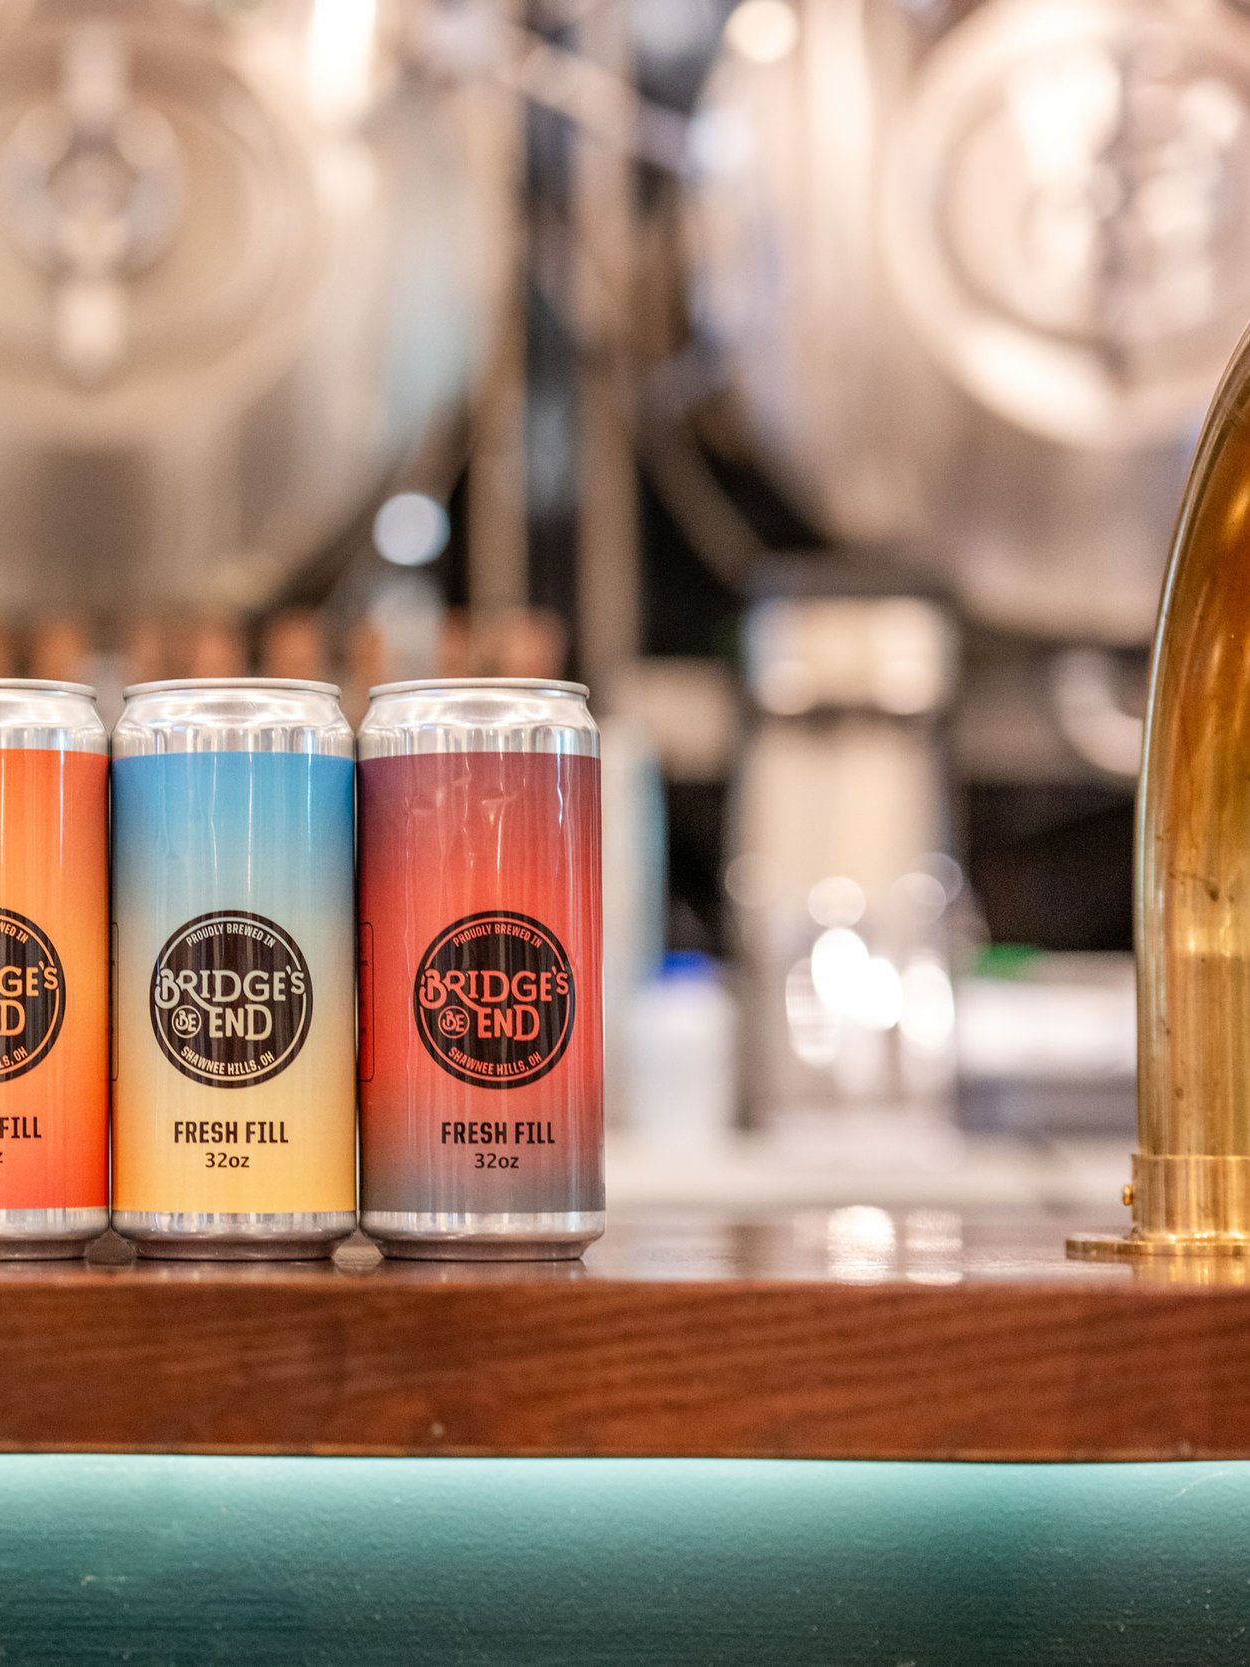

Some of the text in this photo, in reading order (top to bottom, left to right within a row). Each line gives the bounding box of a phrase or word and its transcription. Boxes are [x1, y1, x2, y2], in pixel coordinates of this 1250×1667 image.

[16, 931, 28, 944] IN
[186, 924, 276, 949] PROUDLY BREWED IN
[453, 924, 542, 949] PROUDLY BREWED IN
[155, 965, 304, 1009] BRIDGE'S
[419, 966, 569, 1010] BRIDGE'S
[175, 1010, 196, 1032] BE
[209, 1004, 272, 1040] END
[442, 1011, 464, 1032] BE
[478, 1004, 540, 1040] END
[14, 1046, 28, 1061] OH
[181, 1046, 274, 1075] SHAWNEE HILLS, OH
[448, 1047, 542, 1076] SHAWNEE HILLS, OH
[0, 1117, 41, 1138] FILL
[175, 1122, 288, 1144] FRESH FILL
[442, 1122, 555, 1144] FRESH FILL
[205, 1153, 250, 1168] 32oz
[474, 1153, 519, 1168] 32oz
